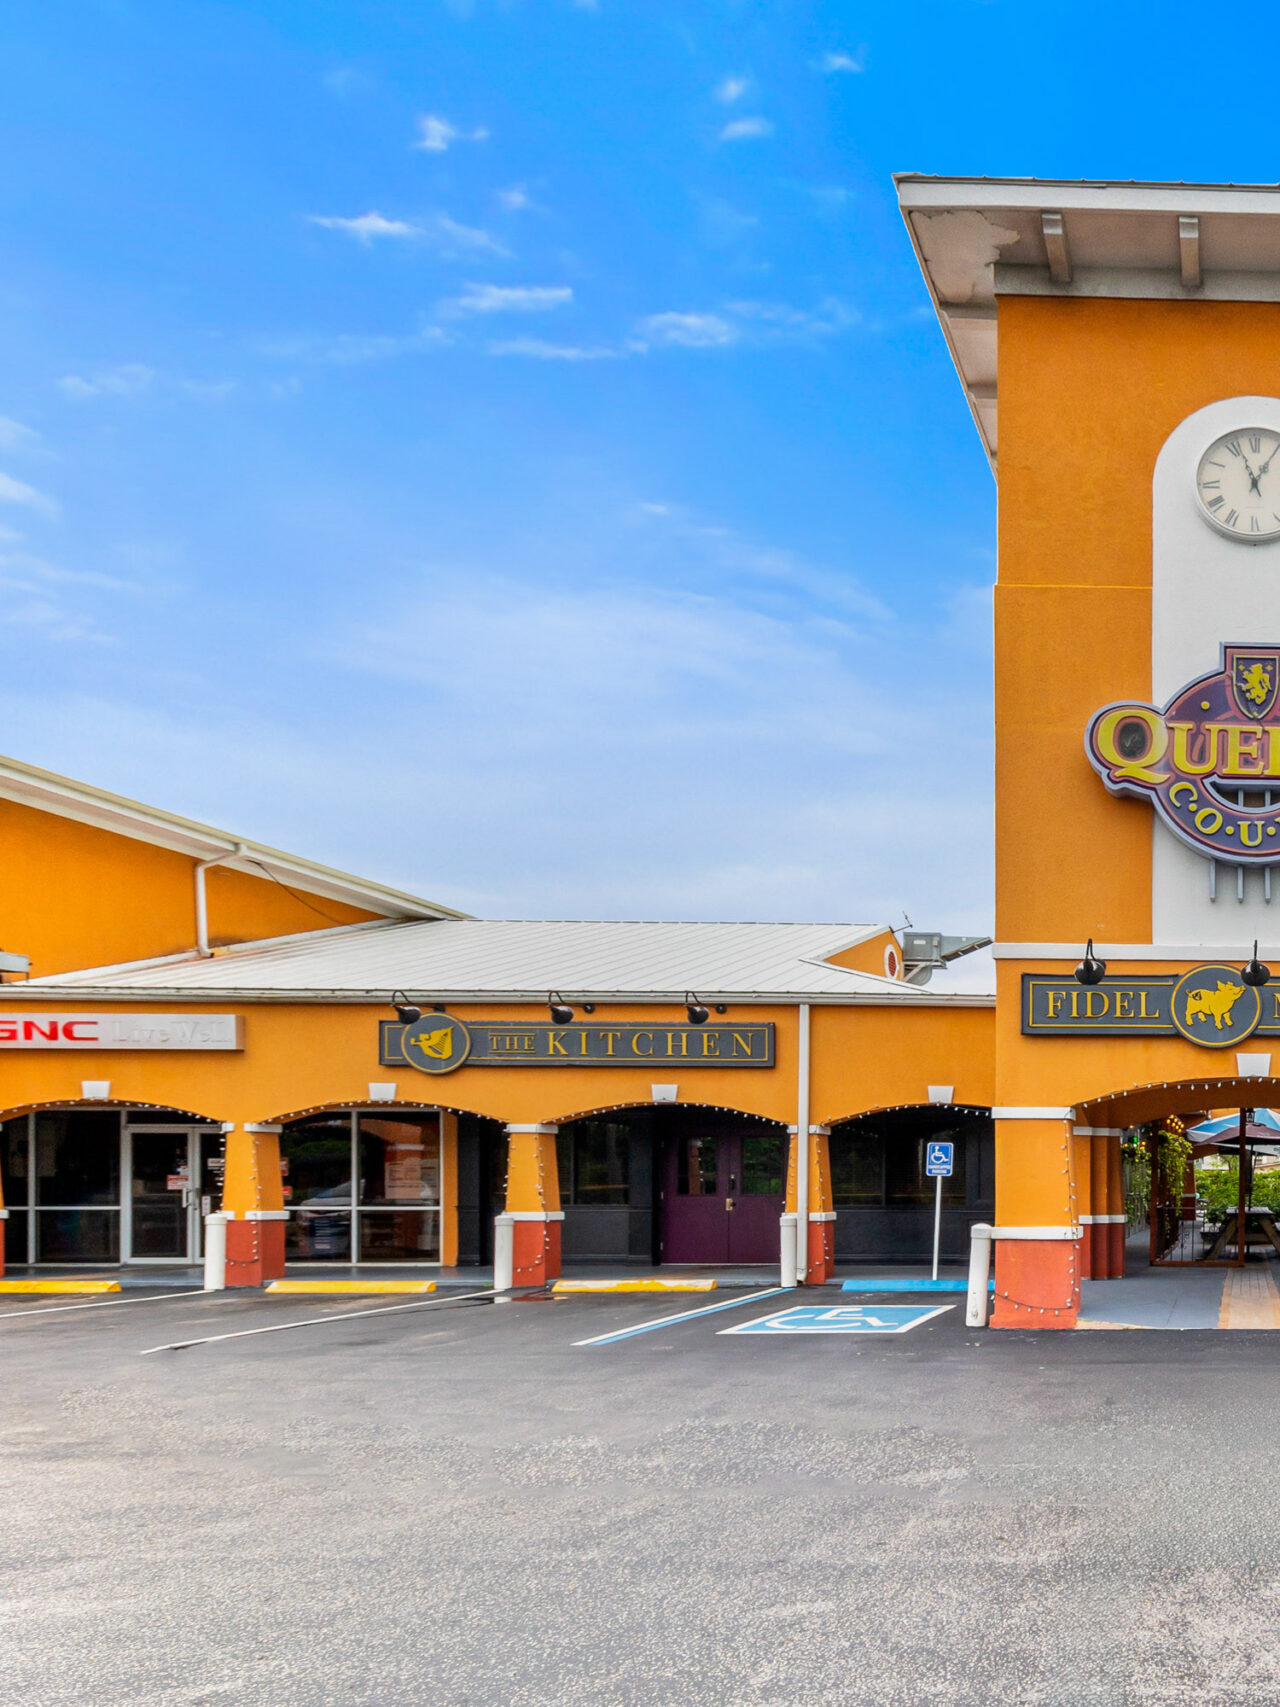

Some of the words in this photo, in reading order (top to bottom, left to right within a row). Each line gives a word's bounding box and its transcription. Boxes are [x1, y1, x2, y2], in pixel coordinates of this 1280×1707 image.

[1045, 990, 1160, 1019] FIDEL
[489, 1033, 536, 1052] THE
[546, 1031, 755, 1058] KITCHEN
